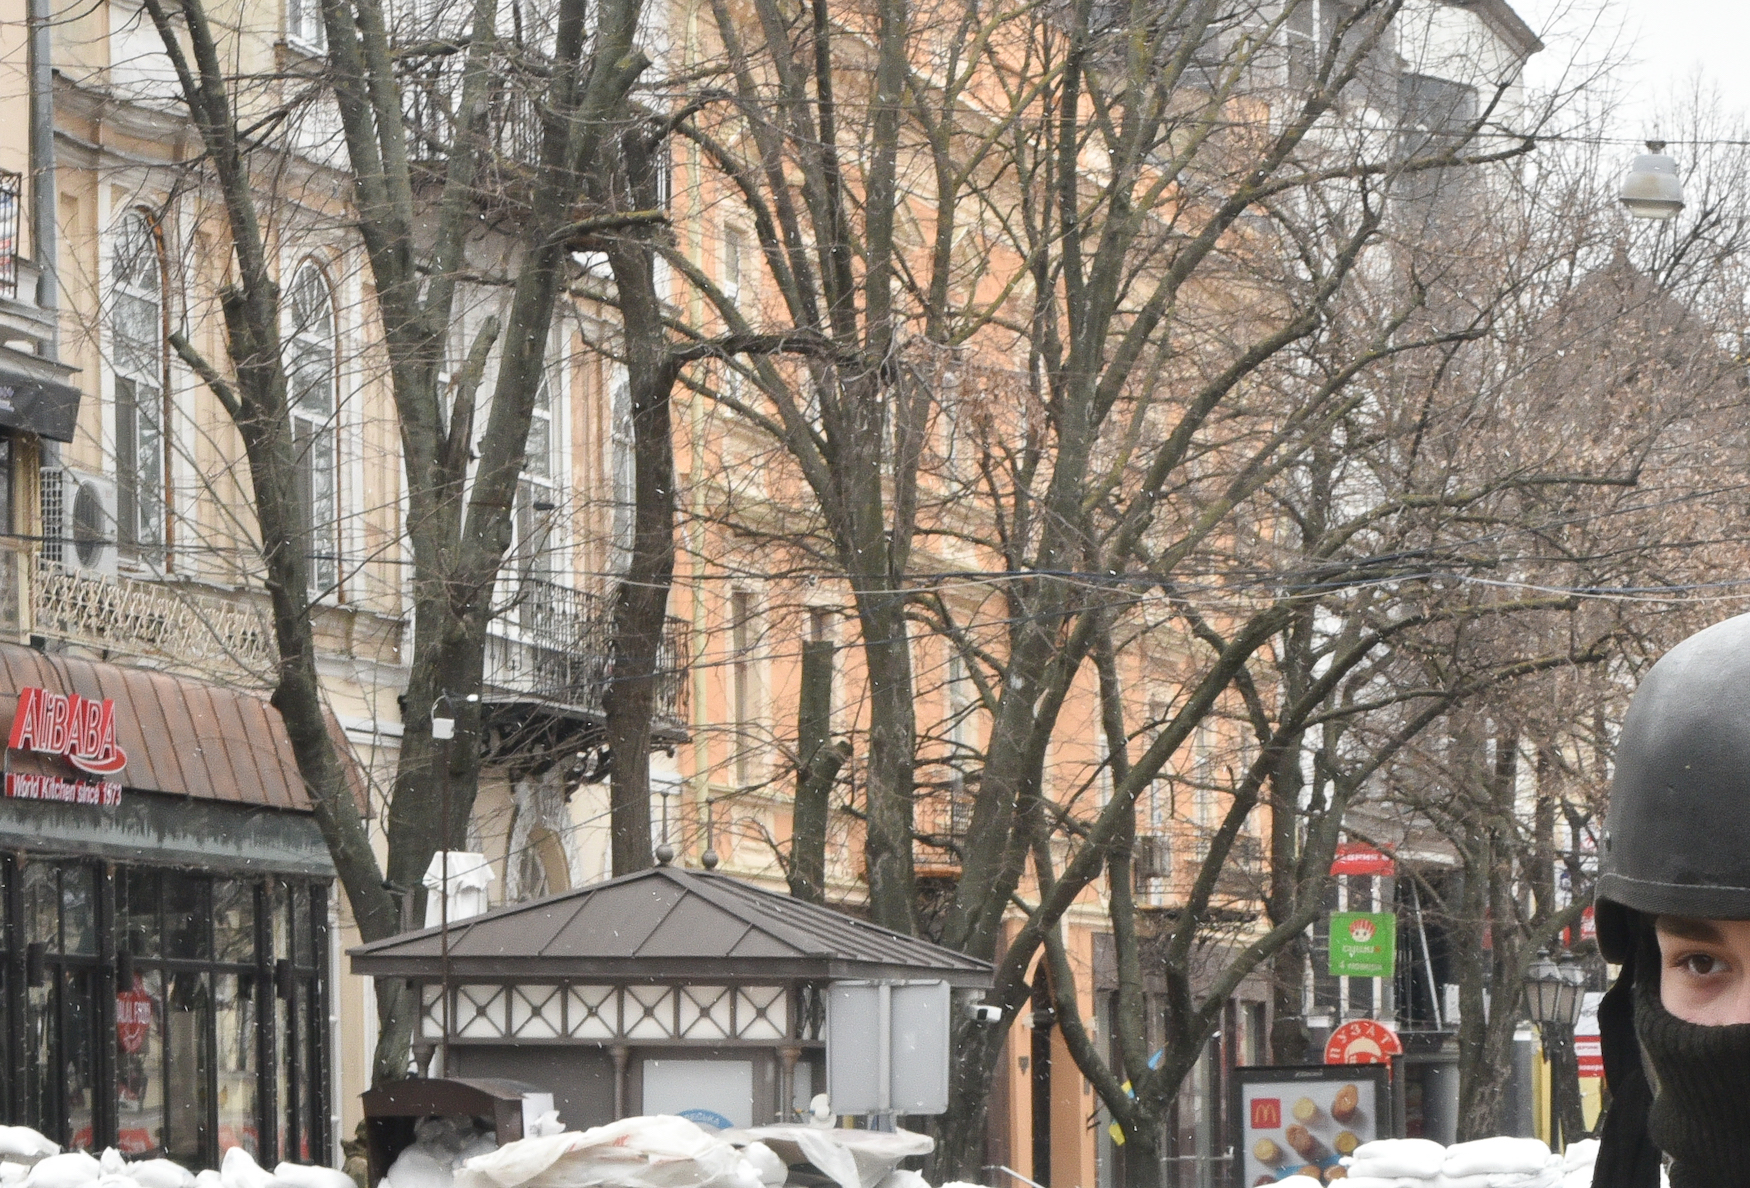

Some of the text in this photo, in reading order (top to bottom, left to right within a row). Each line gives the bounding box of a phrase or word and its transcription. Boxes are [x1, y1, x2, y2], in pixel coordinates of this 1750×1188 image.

[13, 773, 39, 799] World
[41, 775, 76, 802] Kitchen
[77, 780, 100, 804] since
[1329, 1022, 1392, 1060] ПУЗАТ
